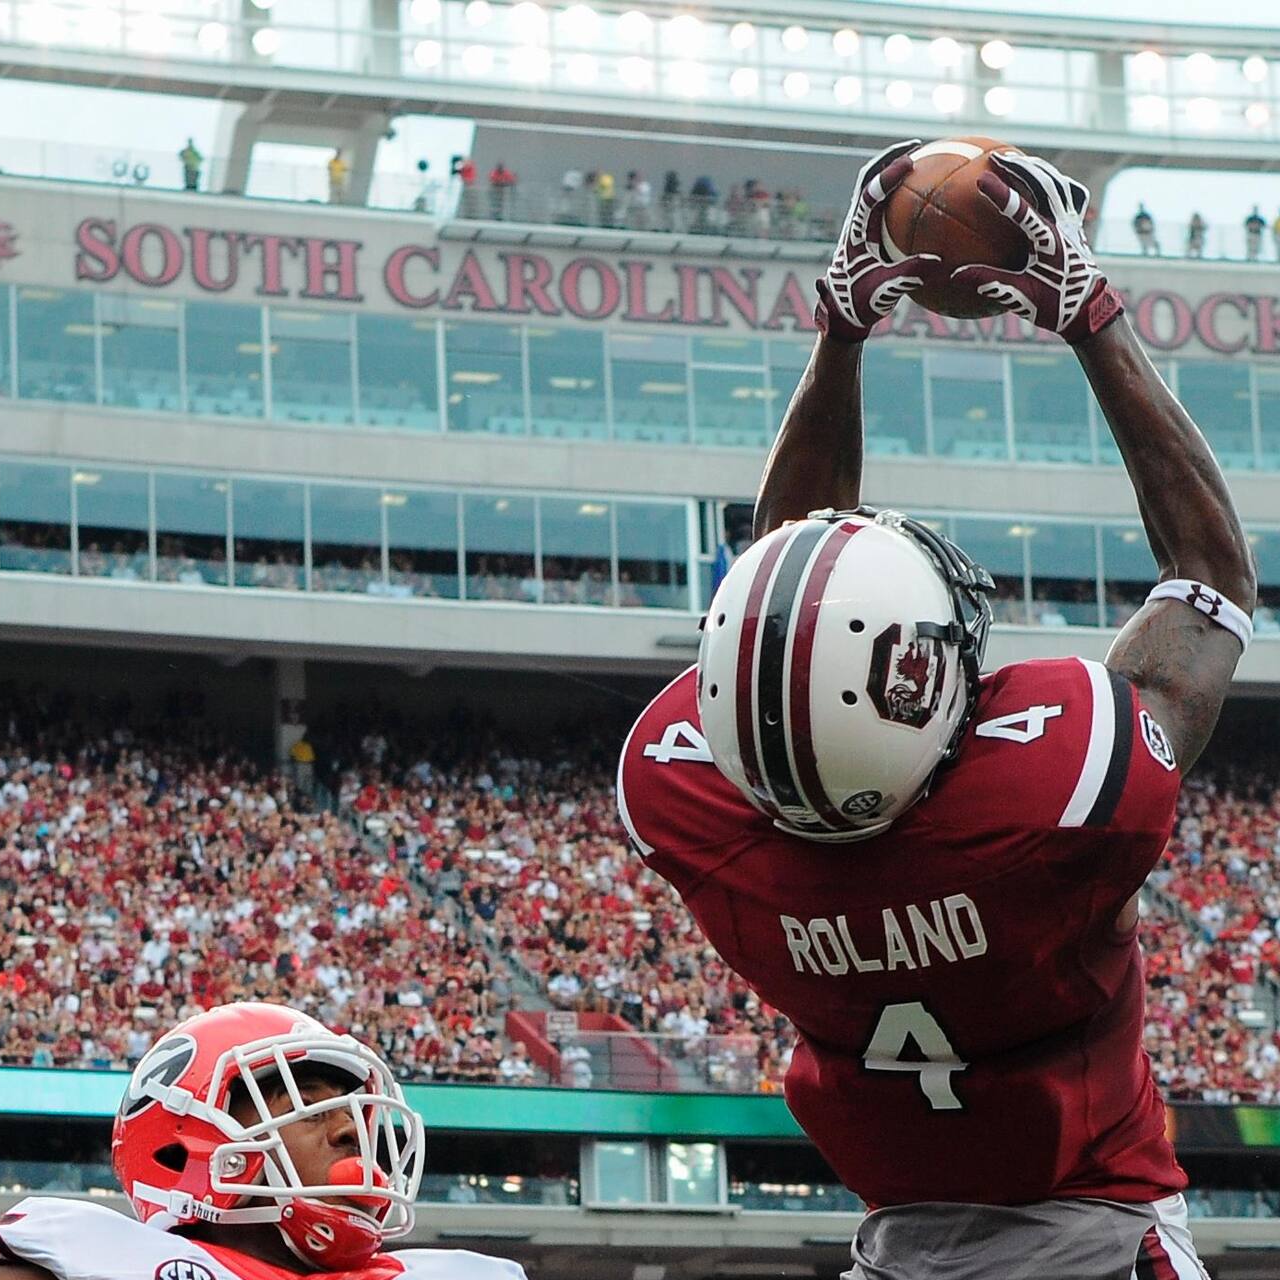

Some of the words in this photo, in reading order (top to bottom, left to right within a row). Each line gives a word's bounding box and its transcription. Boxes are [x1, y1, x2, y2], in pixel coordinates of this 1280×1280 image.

[75, 217, 363, 302] SOUTH
[384, 243, 820, 332] CAROLINA
[643, 719, 715, 763] 4
[975, 704, 1063, 744] 4
[847, 793, 878, 813] SEC
[780, 893, 988, 977] ROLAND
[862, 1001, 969, 1110] 4
